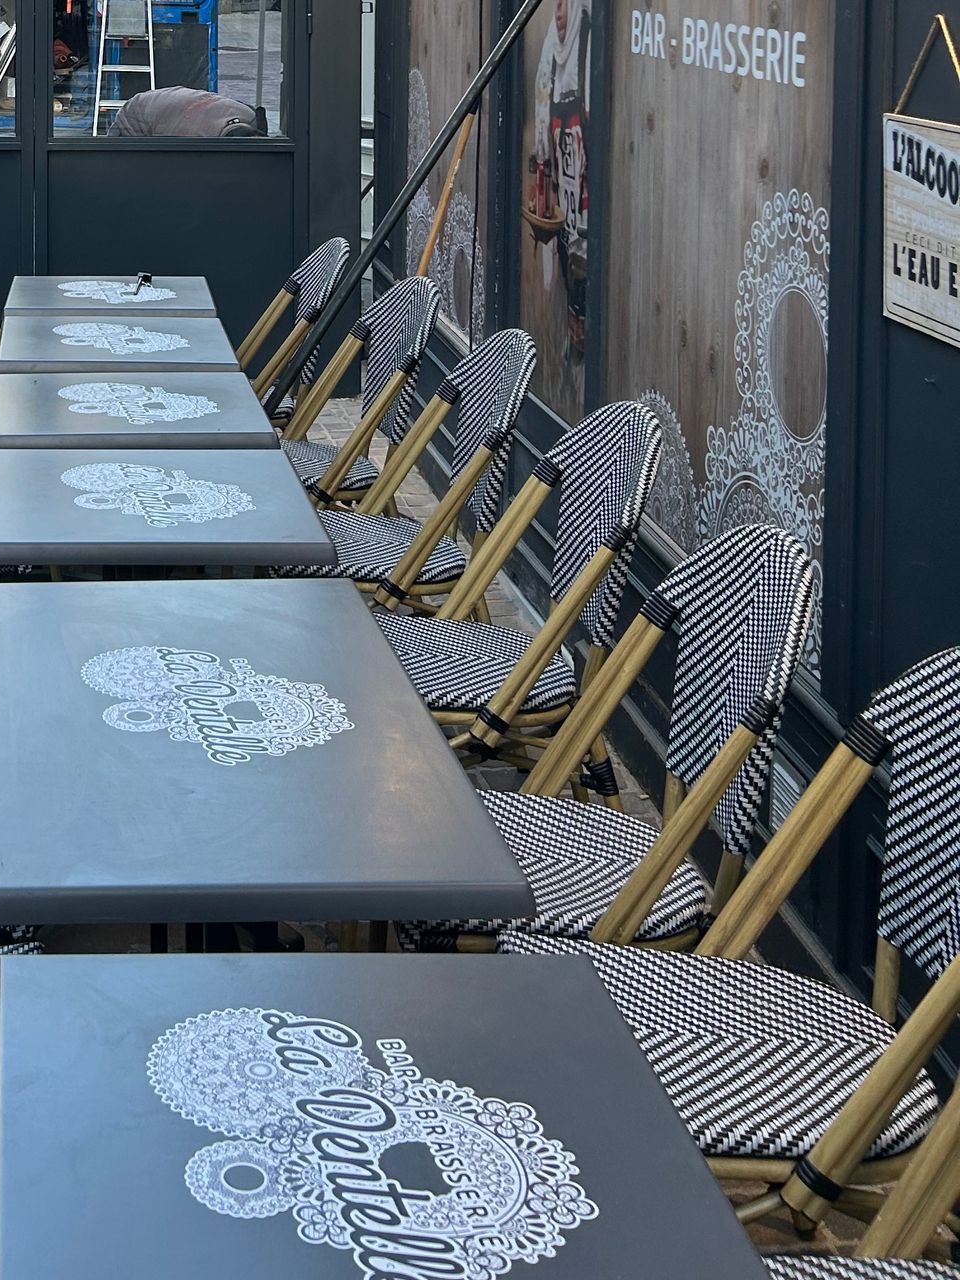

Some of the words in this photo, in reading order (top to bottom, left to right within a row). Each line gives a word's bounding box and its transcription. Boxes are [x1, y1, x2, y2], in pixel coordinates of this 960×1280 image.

[631, 9, 667, 60] BAR
[682, 17, 807, 88] BRASSERIE
[892, 131, 960, 205] L'ALCOO
[893, 242, 940, 291] L'EAU
[905, 231, 931, 249] CECI
[937, 241, 957, 259] DIT
[155, 647, 219, 676] La
[173, 679, 270, 766] Dentelle
[260, 1012, 362, 1078] La
[377, 1038, 422, 1082] BAR
[414, 1108, 506, 1249] BRASSERIE
